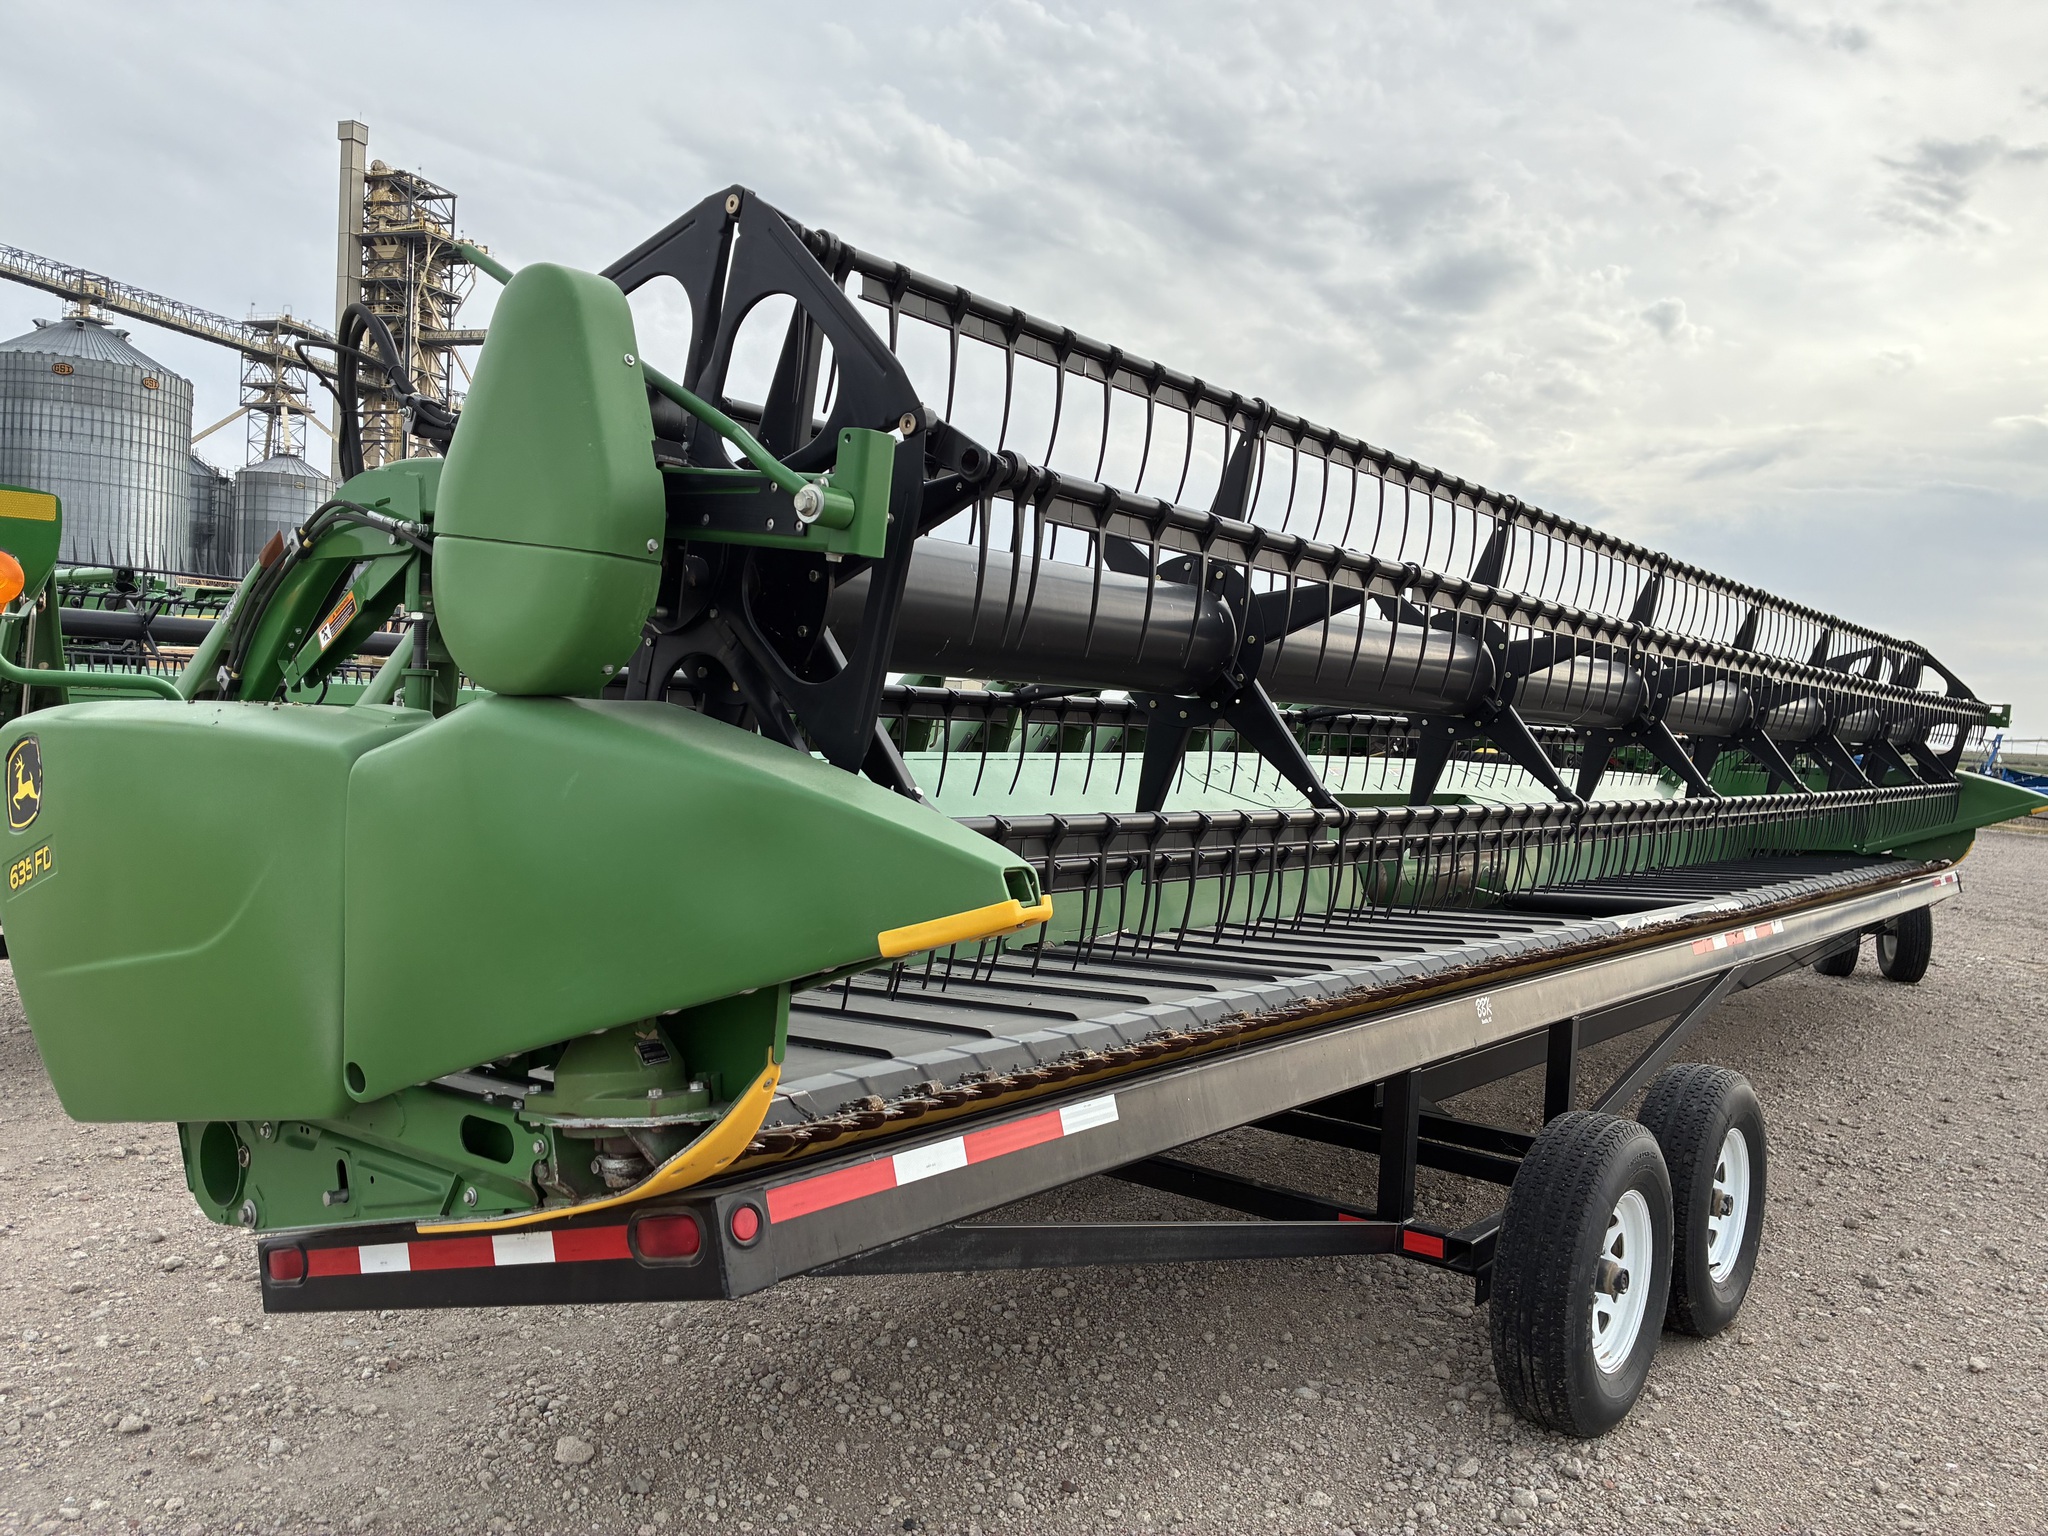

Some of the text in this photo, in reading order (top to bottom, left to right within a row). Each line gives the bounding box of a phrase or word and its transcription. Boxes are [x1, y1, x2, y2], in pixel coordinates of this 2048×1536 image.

[54, 364, 71, 373] GSI
[144, 379, 158, 388] GSI
[9, 845, 52, 890] 635 FD
